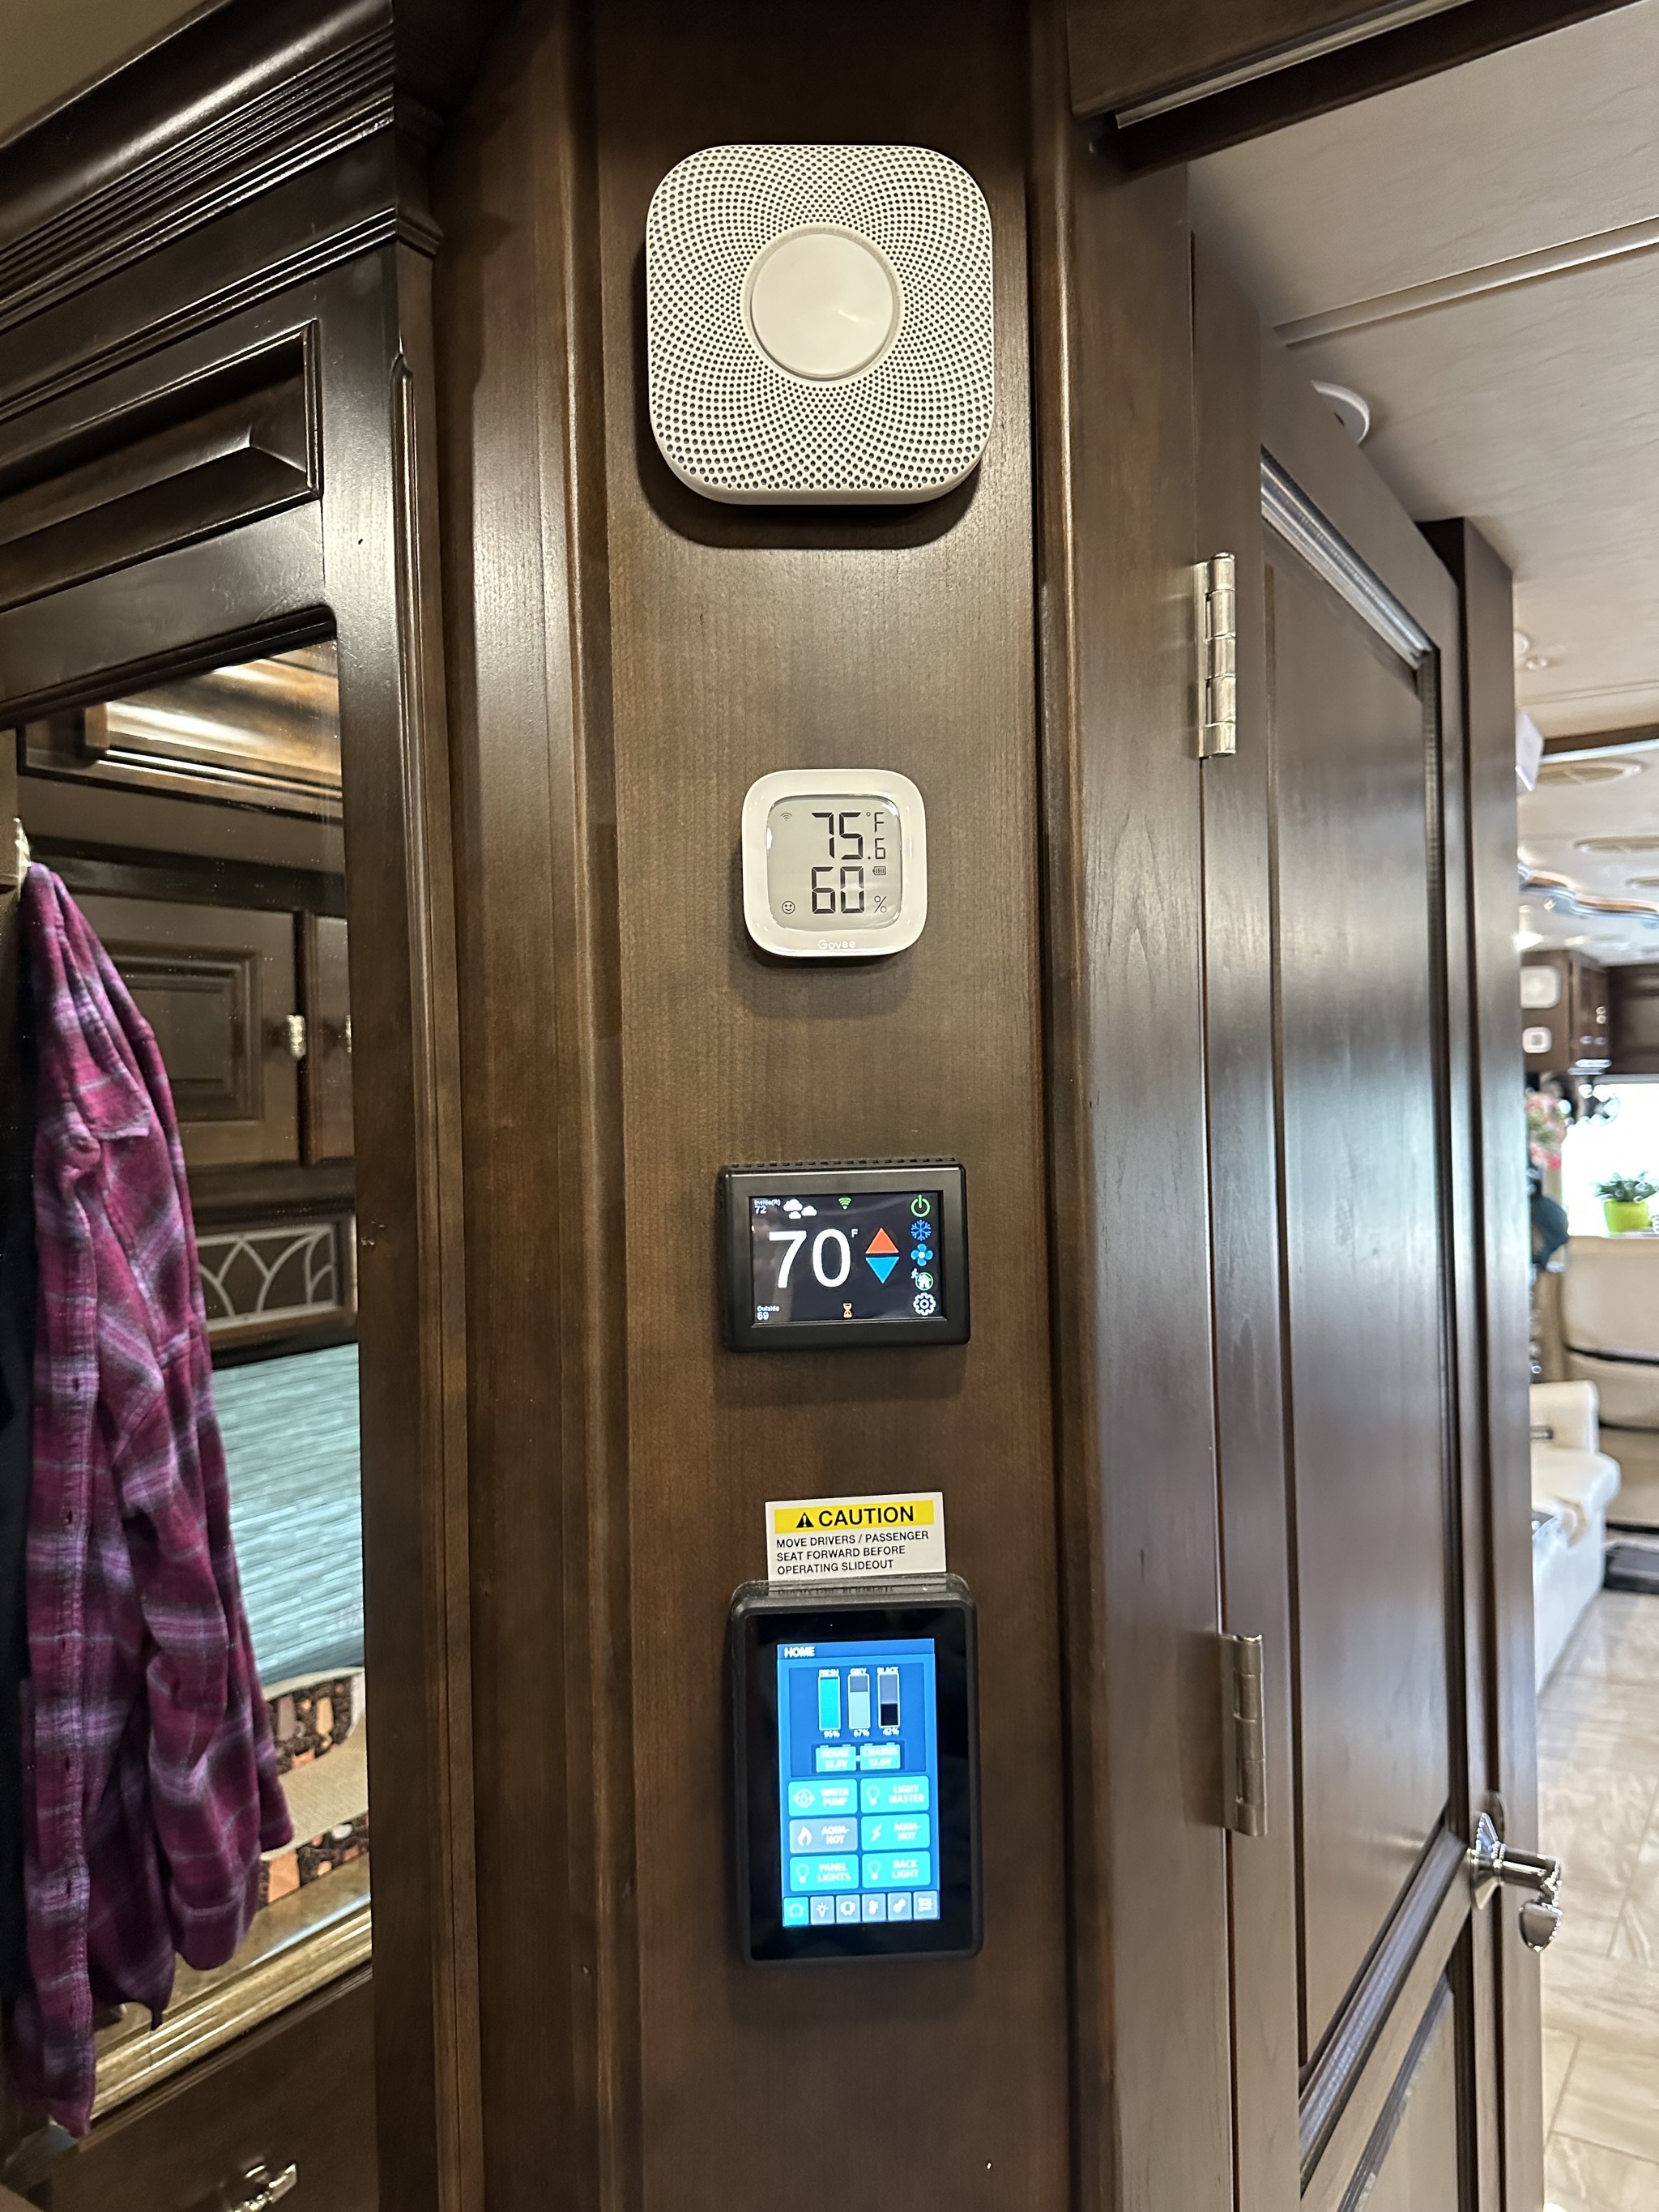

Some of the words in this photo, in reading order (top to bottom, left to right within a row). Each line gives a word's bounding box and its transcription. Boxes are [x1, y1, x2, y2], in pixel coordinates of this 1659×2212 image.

[811, 866, 865, 914] 60
[817, 940, 856, 950] Govee
[769, 1228, 851, 1288] 70
[757, 1312, 769, 1320] 69
[818, 1505, 915, 1527] CAUTION
[776, 1538, 808, 1548] MOVE
[810, 1535, 855, 1547] DRIVERS
[865, 1531, 928, 1544] PASSENGER
[777, 1552, 804, 1561] SEAT
[807, 1548, 860, 1561] FORWARD
[863, 1545, 906, 1557] BEFORE
[778, 1562, 838, 1575] OPERATING
[842, 1559, 894, 1571] SLIDEOUT
[783, 1646, 815, 1658] HOME
[821, 1787, 850, 1796] WATER
[893, 1784, 919, 1794] LIGHT
[822, 1797, 848, 1807] PUMP
[889, 1794, 924, 1804] MASTER
[825, 1834, 846, 1845] HOT
[898, 1831, 916, 1841] HOT
[819, 1863, 847, 1873] PANEL
[893, 1860, 919, 1869] BACK
[817, 1873, 851, 1883] LIGHTS
[892, 1868, 919, 1879] LIGHT
